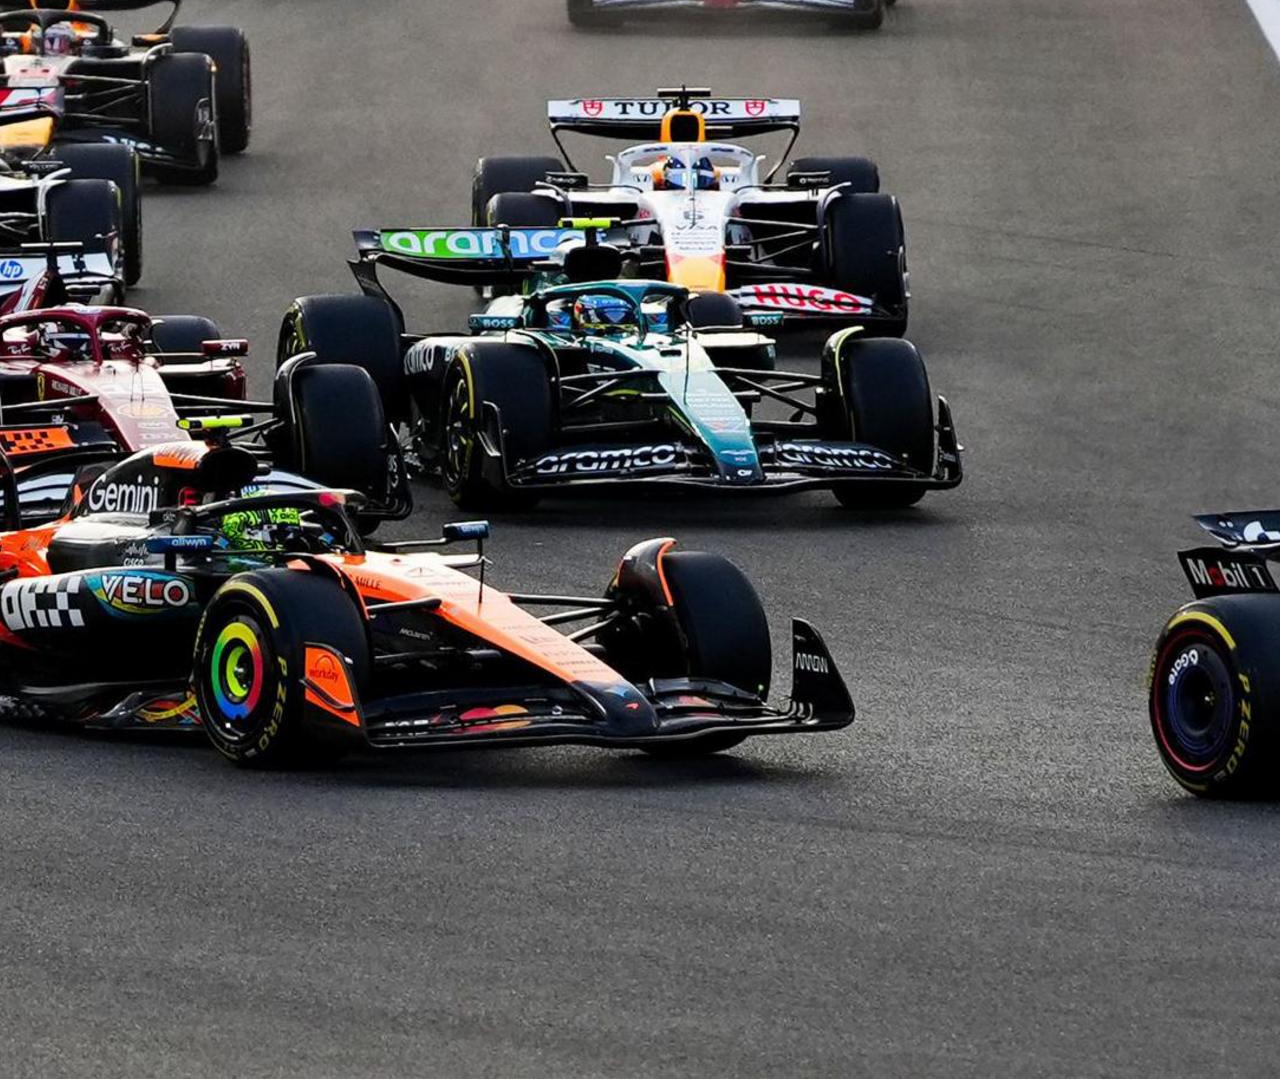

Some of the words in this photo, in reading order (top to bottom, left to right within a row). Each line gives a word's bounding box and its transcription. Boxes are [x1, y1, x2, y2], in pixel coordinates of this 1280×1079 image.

[2, 261, 22, 278] hp
[753, 285, 861, 312] HUGO
[482, 318, 515, 328] BOSS
[751, 315, 779, 326] BOSS
[220, 342, 241, 351] ZYN
[535, 444, 677, 475] aramco
[779, 440, 893, 471] aramco
[89, 474, 159, 514] Gemini
[171, 536, 208, 550] allwyn
[1186, 557, 1250, 588] Mobil
[1253, 566, 1267, 587] 1
[102, 574, 190, 608] VELO
[309, 669, 340, 683] workday
[258, 673, 288, 753] ZERO
[1226, 698, 1252, 774] ZERO
